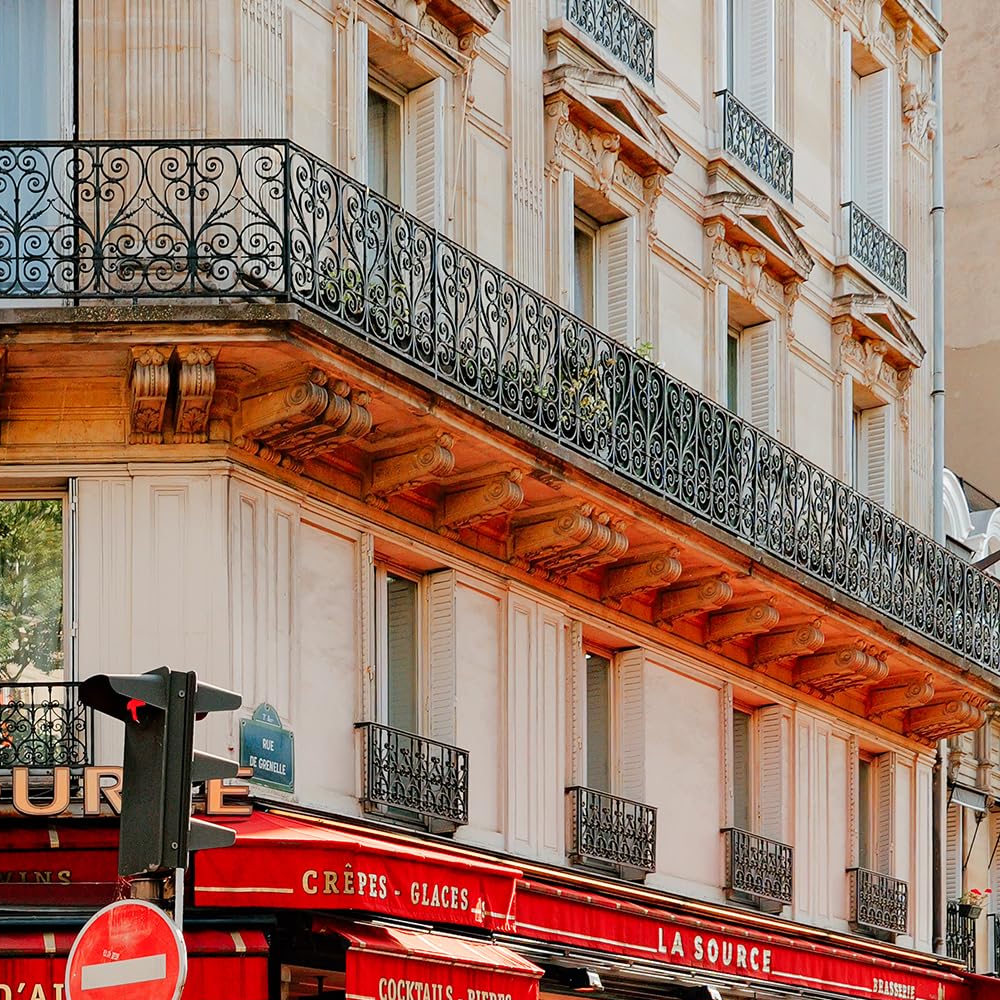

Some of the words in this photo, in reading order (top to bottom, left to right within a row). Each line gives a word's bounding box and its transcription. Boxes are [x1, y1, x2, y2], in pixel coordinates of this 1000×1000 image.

[262, 738, 275, 751] RUE
[249, 755, 258, 767] DE
[258, 757, 287, 775] GRENELLE
[302, 863, 387, 899] CRÊPES
[410, 881, 469, 911] GLACES
[658, 927, 685, 957] LA
[693, 935, 771, 973] SOURCE
[872, 977, 916, 1000] BRASSERIE
